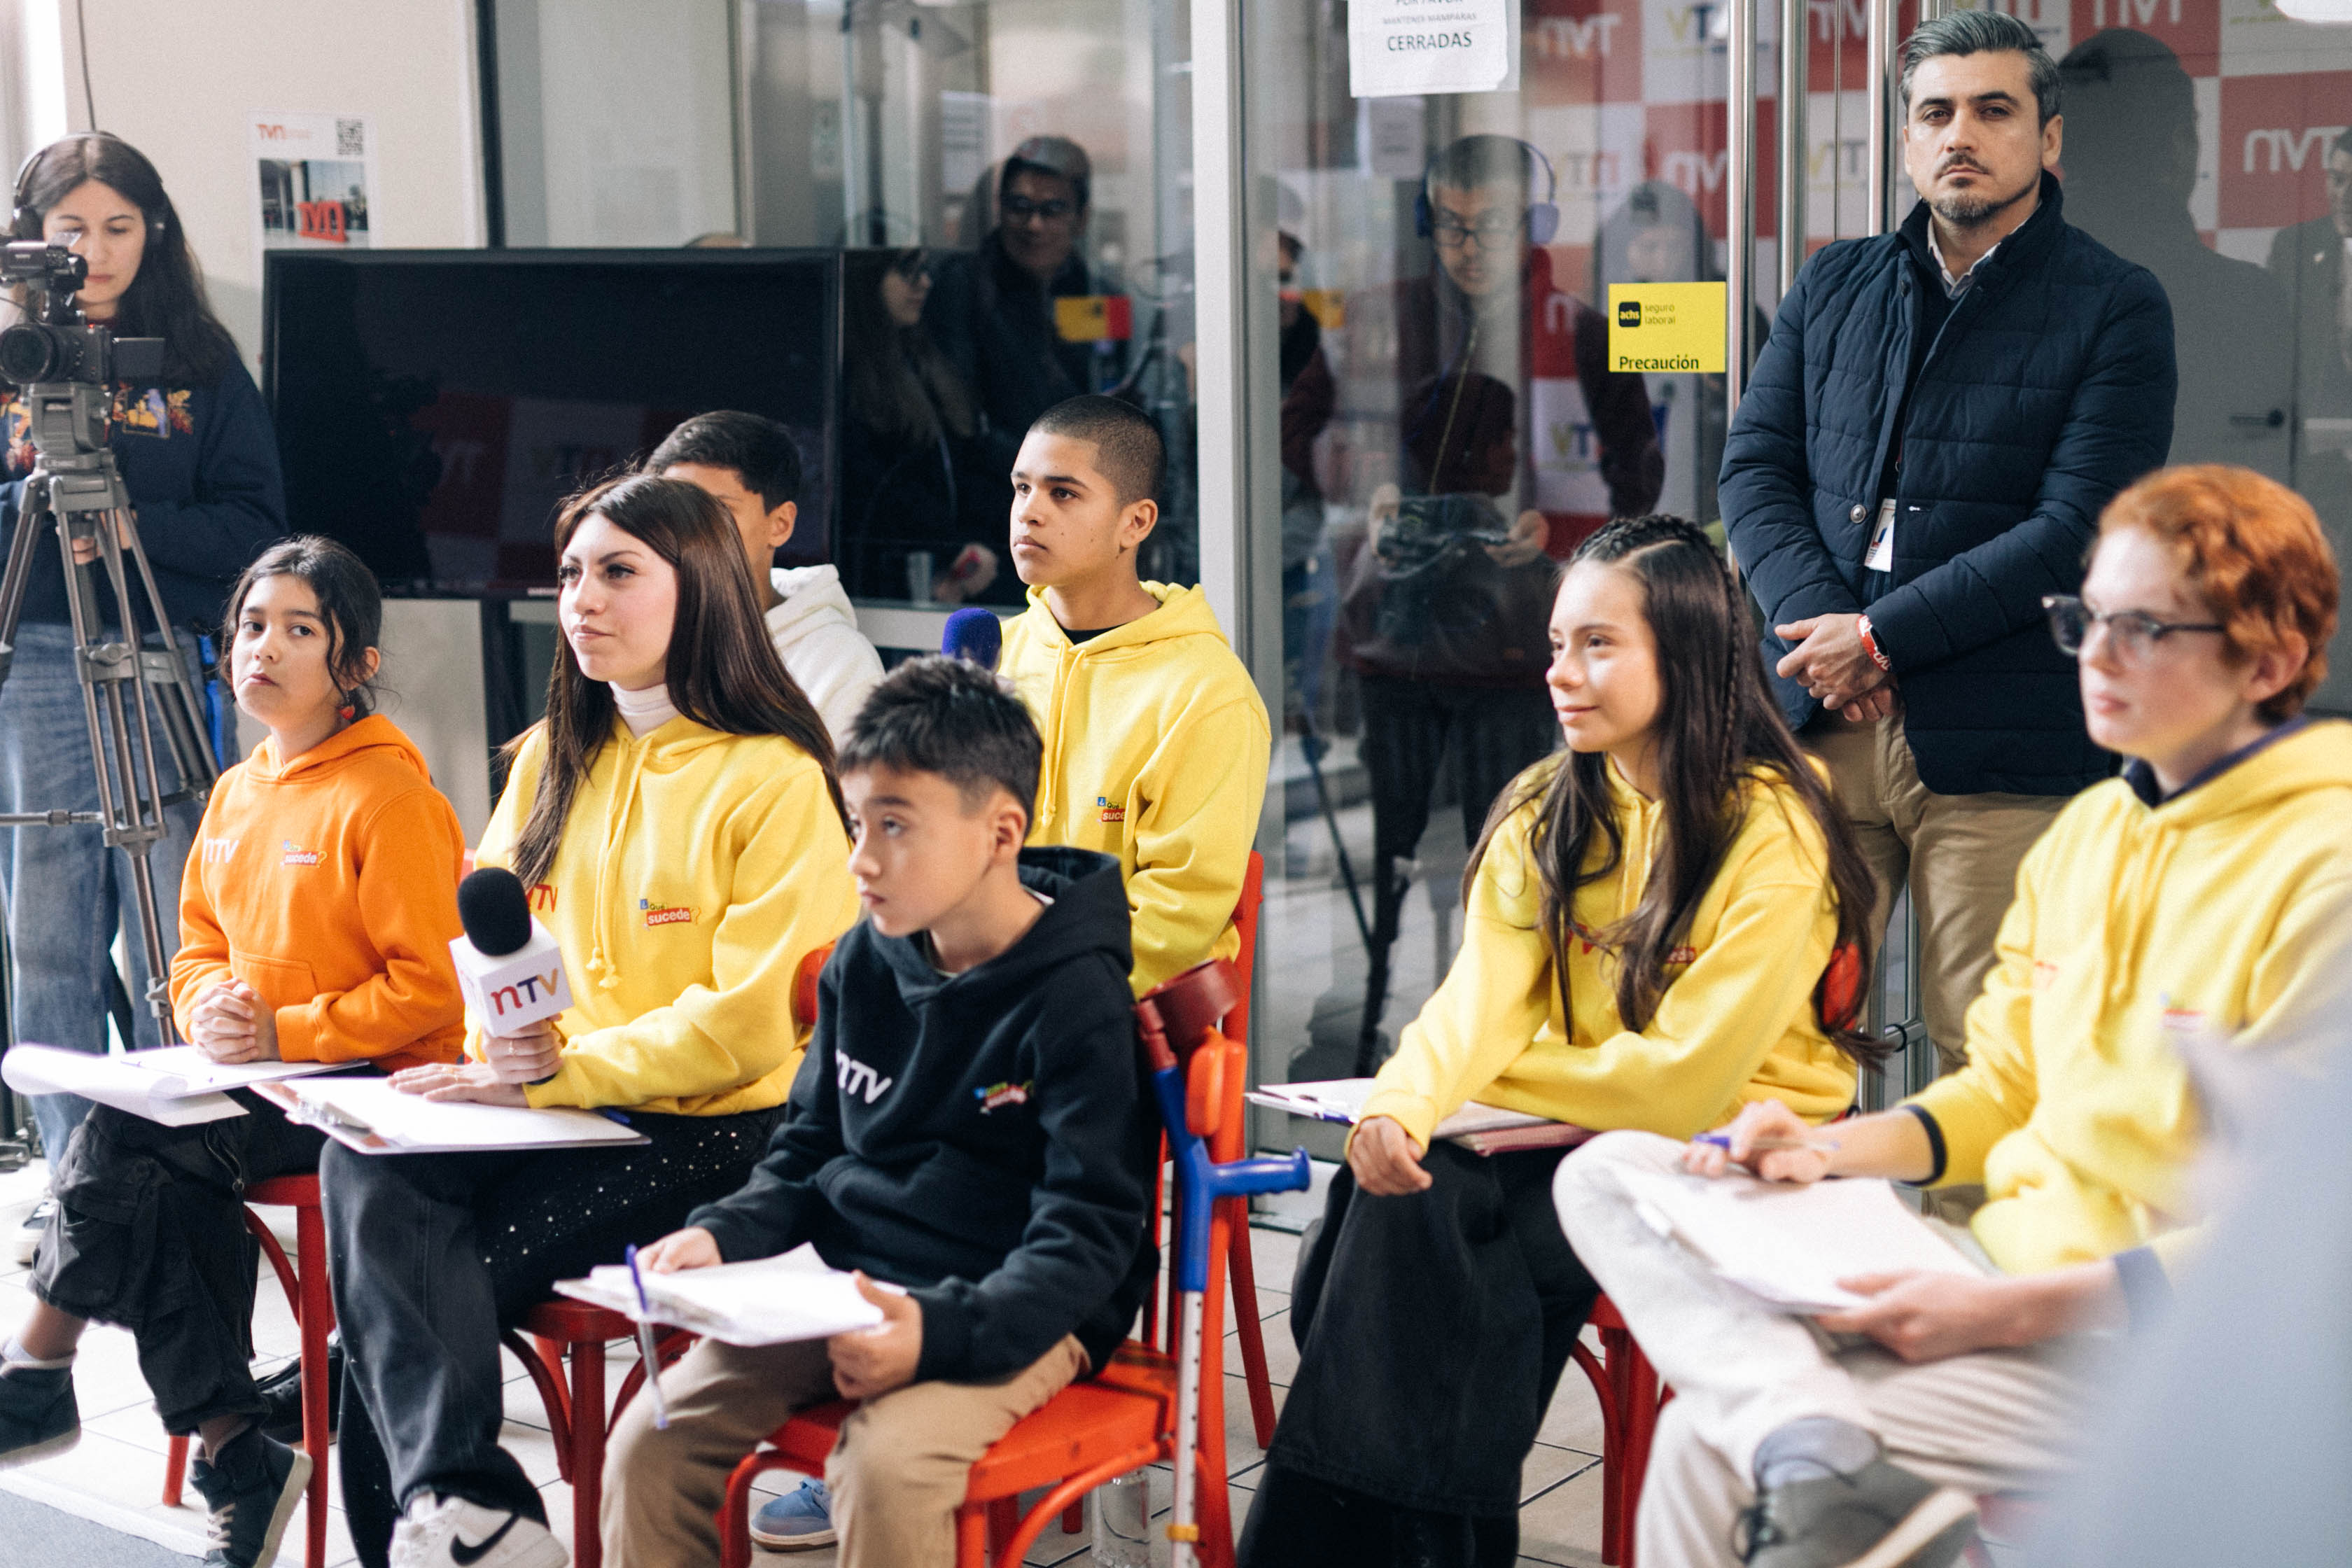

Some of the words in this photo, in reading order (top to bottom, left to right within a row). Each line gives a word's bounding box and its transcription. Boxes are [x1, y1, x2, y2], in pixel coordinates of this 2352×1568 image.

[1387, 31, 1472, 51] CERRADAS
[1620, 309, 1640, 320] achs
[1645, 304, 1675, 314] seguro
[1645, 315, 1676, 325] laboral
[1619, 354, 1700, 370] Precaución
